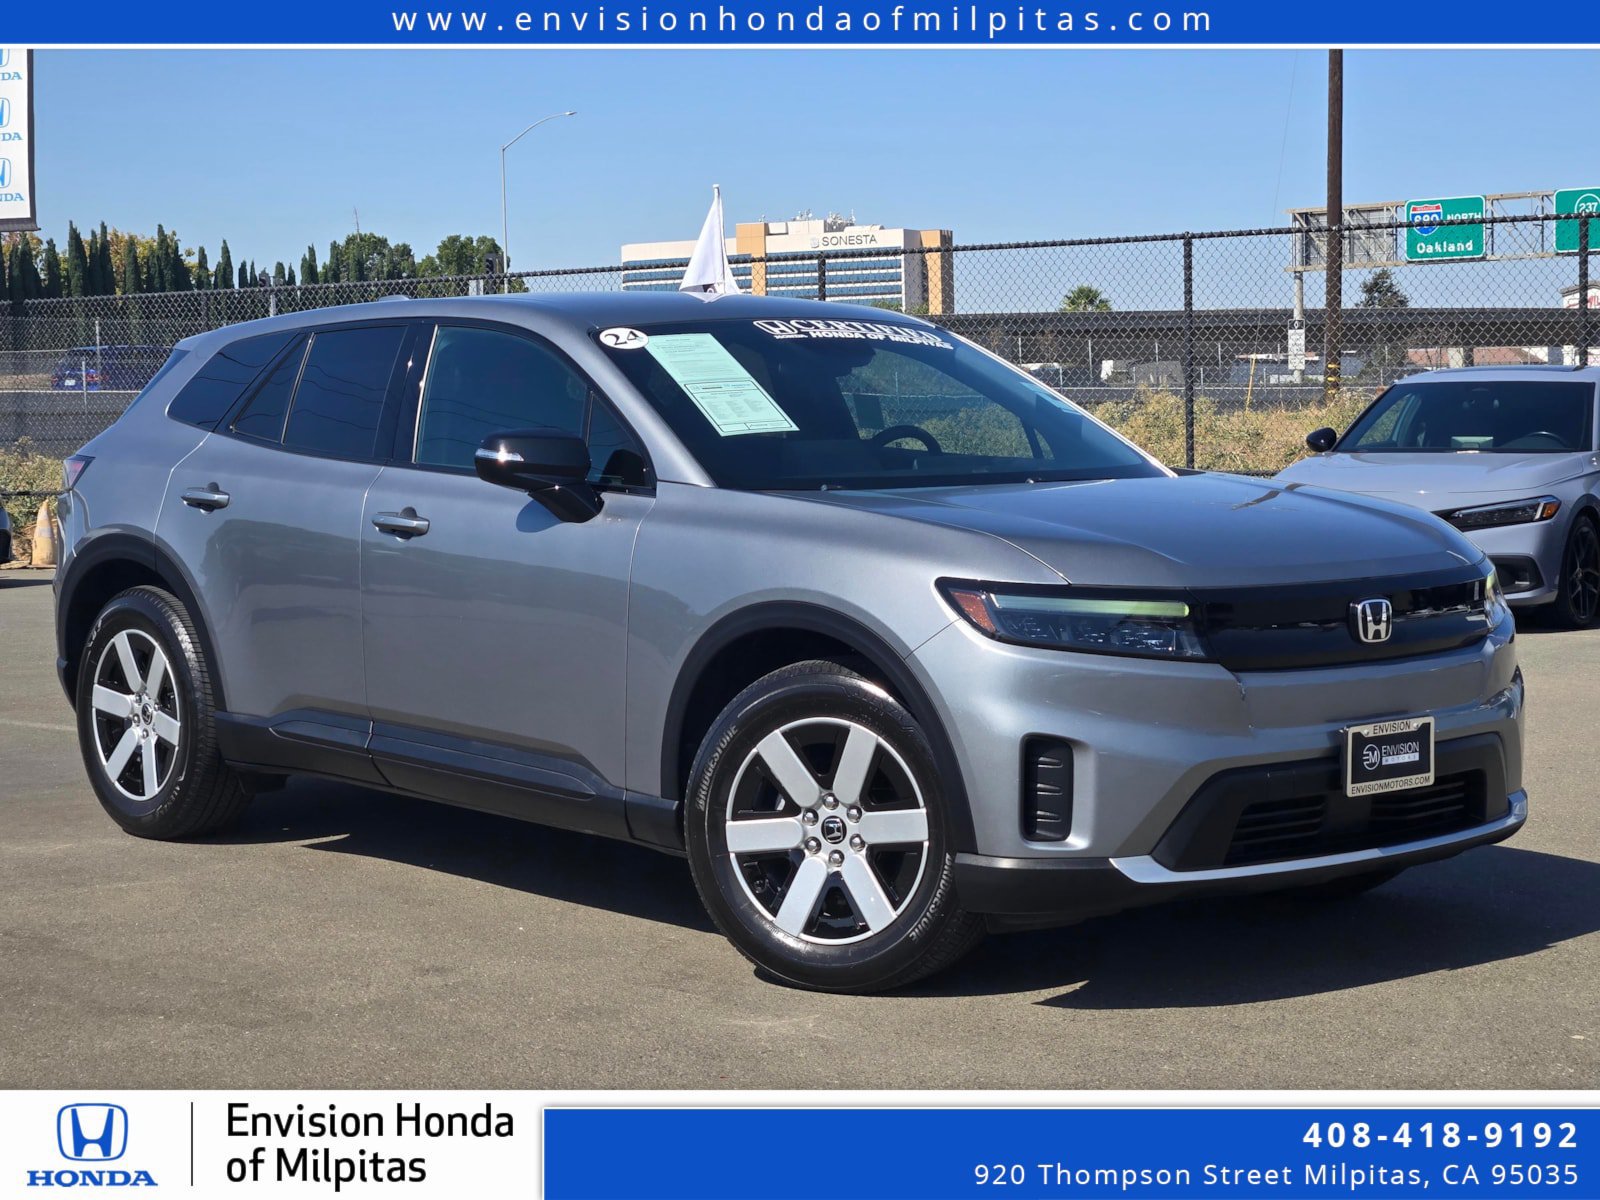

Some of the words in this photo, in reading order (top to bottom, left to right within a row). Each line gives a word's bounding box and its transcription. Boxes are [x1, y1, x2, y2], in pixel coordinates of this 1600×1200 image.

[822, 234, 878, 247] SONESTA
[1416, 240, 1474, 254] Oakland
[604, 330, 645, 346] 24
[810, 331, 866, 340] HONDA
[1373, 720, 1411, 735] ENVISION
[1381, 741, 1420, 757] ENVISION
[1351, 775, 1431, 795] ENVISIONMOTORS.COM
